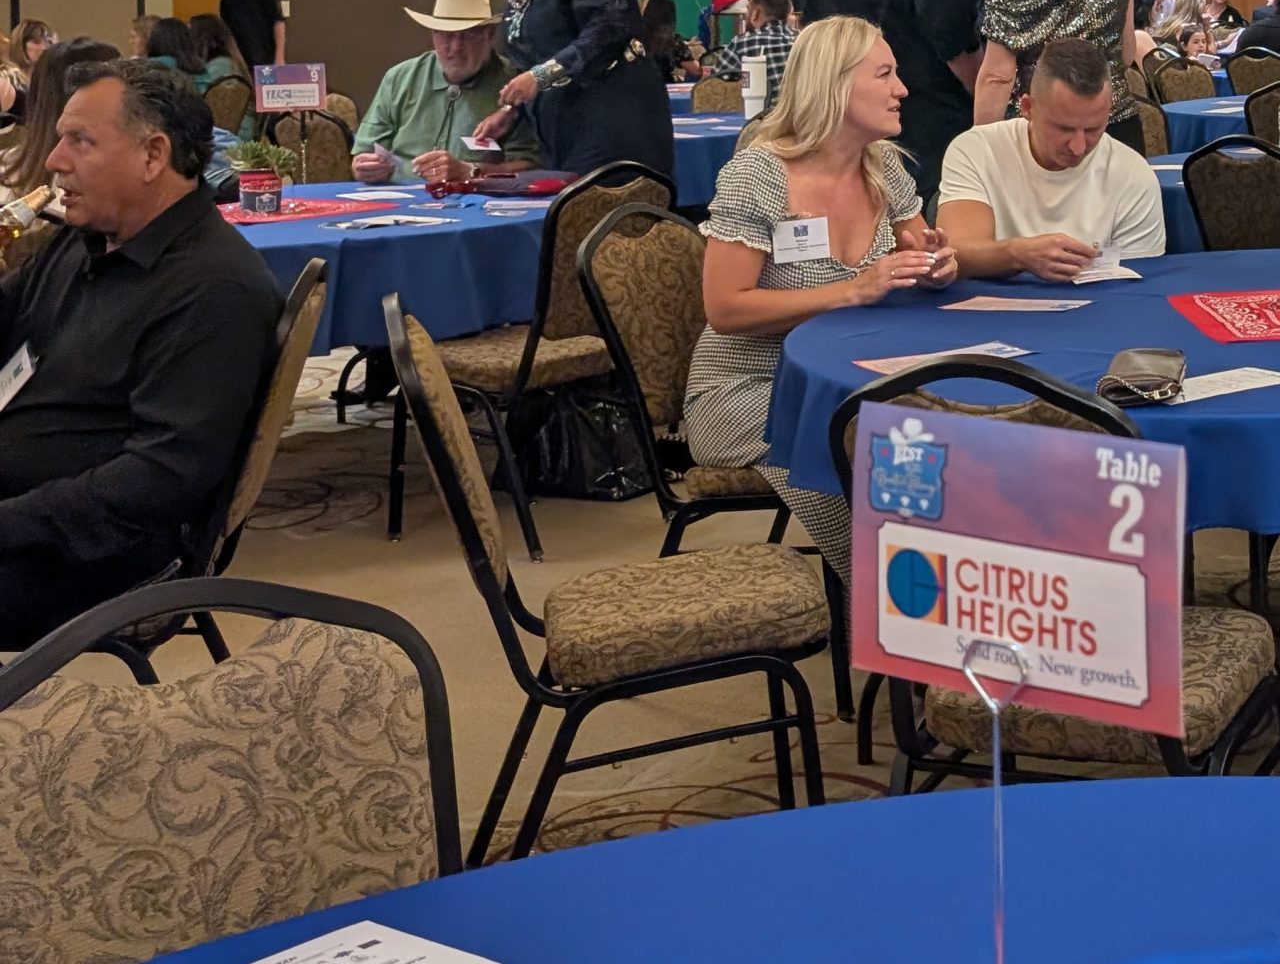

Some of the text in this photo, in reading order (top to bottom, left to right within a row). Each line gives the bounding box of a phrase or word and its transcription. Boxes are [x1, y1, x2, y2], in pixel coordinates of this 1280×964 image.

[310, 70, 319, 83] 9
[1096, 447, 1162, 487] Table
[1108, 483, 1145, 558] 2
[955, 558, 1069, 612] CITRUS
[956, 596, 1098, 657] HEIGHTS
[955, 635, 991, 660] Slid
[994, 649, 1033, 670] roos.
[1039, 652, 1077, 677] New
